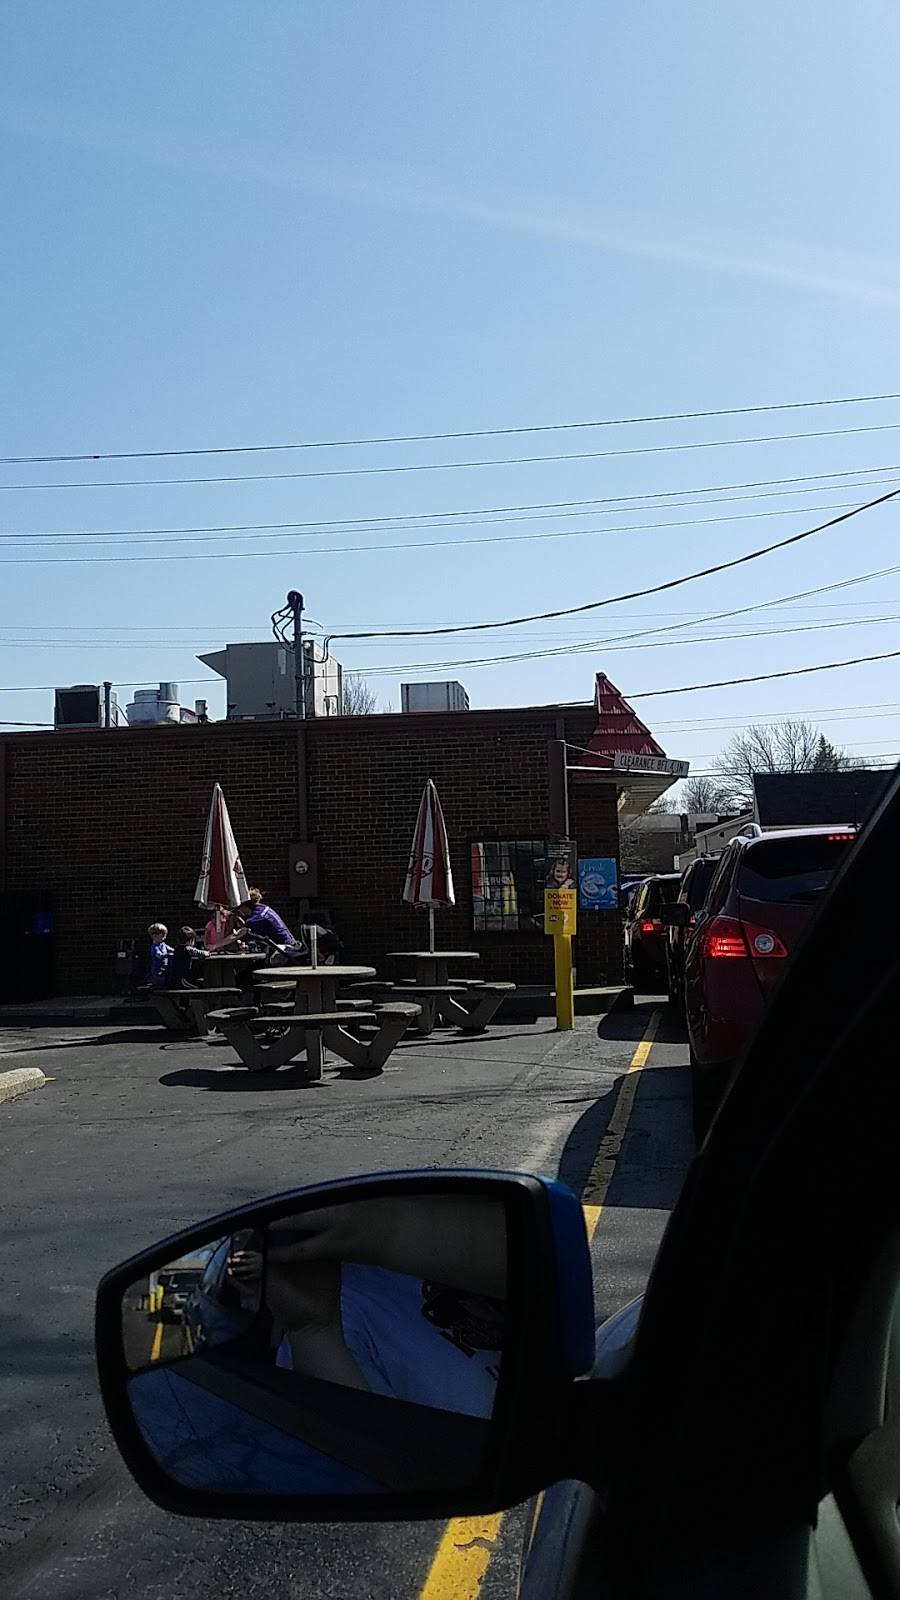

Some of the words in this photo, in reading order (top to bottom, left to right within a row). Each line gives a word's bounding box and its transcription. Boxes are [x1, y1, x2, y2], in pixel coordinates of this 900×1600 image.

[620, 755, 655, 769] CLEARANCE
[547, 892, 573, 900] DONATE
[553, 899, 569, 907] NOW
